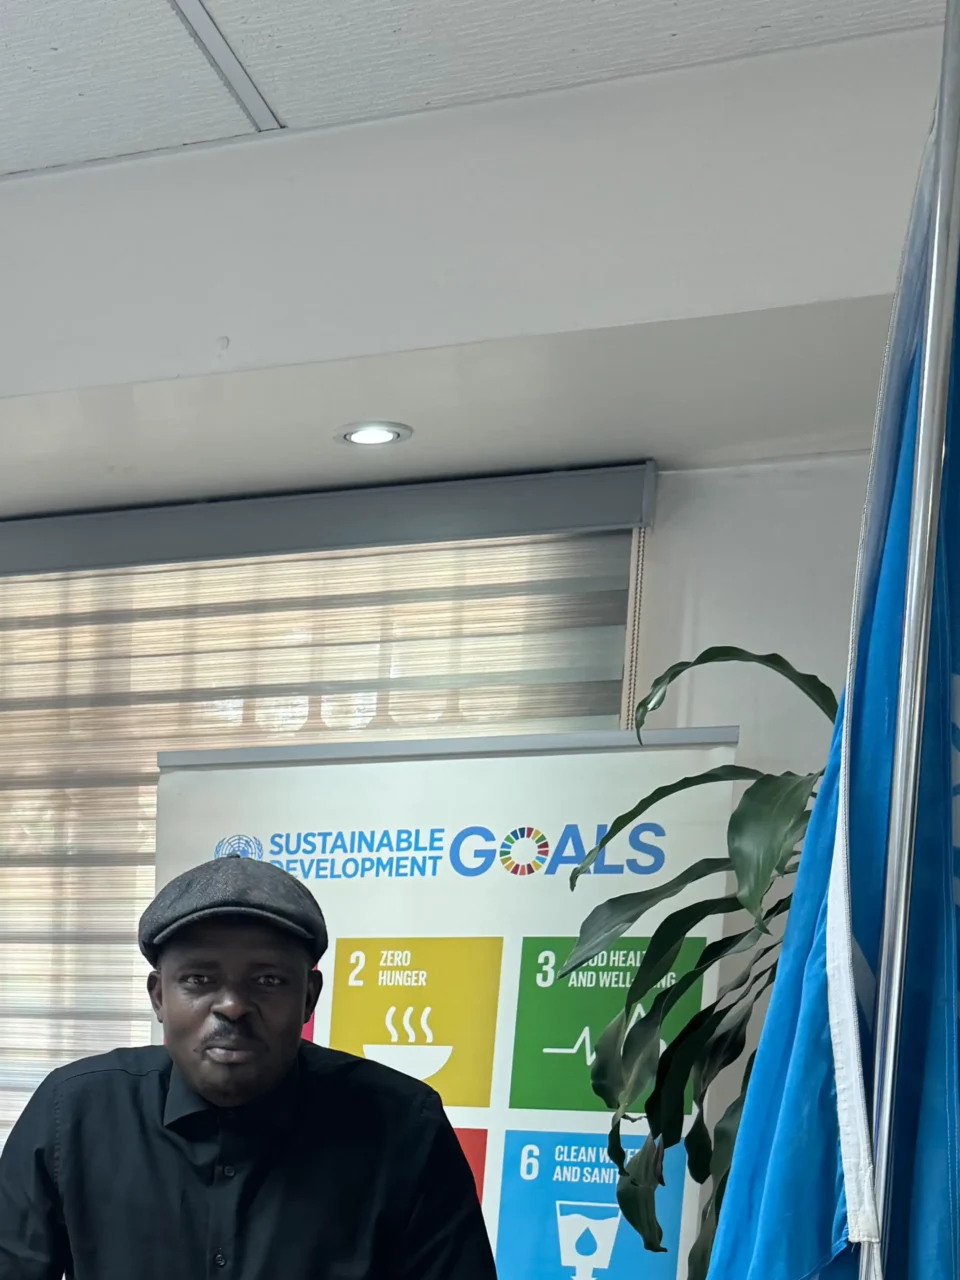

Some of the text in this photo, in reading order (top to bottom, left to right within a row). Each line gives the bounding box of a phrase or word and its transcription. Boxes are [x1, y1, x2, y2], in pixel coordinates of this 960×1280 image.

[269, 828, 445, 855] SUSTAINABLE
[449, 822, 666, 877] GOALS
[380, 950, 411, 967] ZERO
[609, 951, 646, 967] HEAL
[348, 950, 366, 986] 2
[536, 950, 556, 988] 3
[378, 970, 427, 987] HUNGER
[568, 971, 596, 987] AND
[520, 1144, 540, 1181] 6
[555, 1145, 596, 1163] CLEAN
[553, 1166, 580, 1182] AND
